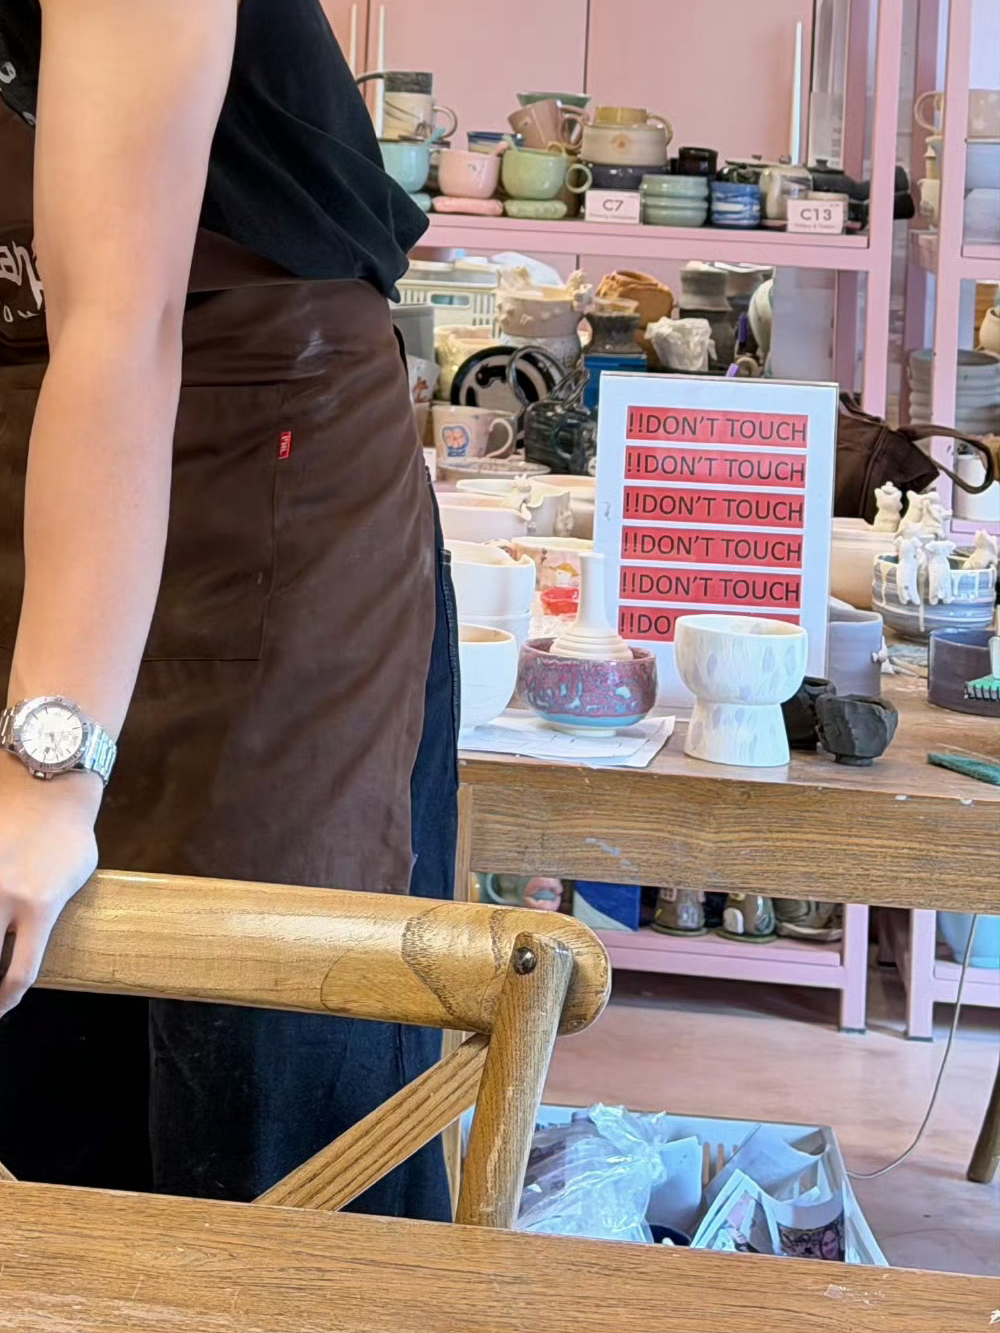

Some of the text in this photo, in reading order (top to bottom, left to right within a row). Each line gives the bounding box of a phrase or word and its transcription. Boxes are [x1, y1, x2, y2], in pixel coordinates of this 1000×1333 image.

[602, 198, 624, 212] C7
[800, 208, 832, 222] C13
[727, 419, 807, 442] TOUCH
[725, 459, 805, 483] TOUCH
[723, 499, 803, 523] TOUCH
[721, 539, 802, 562] TOUCH
[720, 579, 800, 603] TOUCH
[620, 612, 676, 636] !!DO
